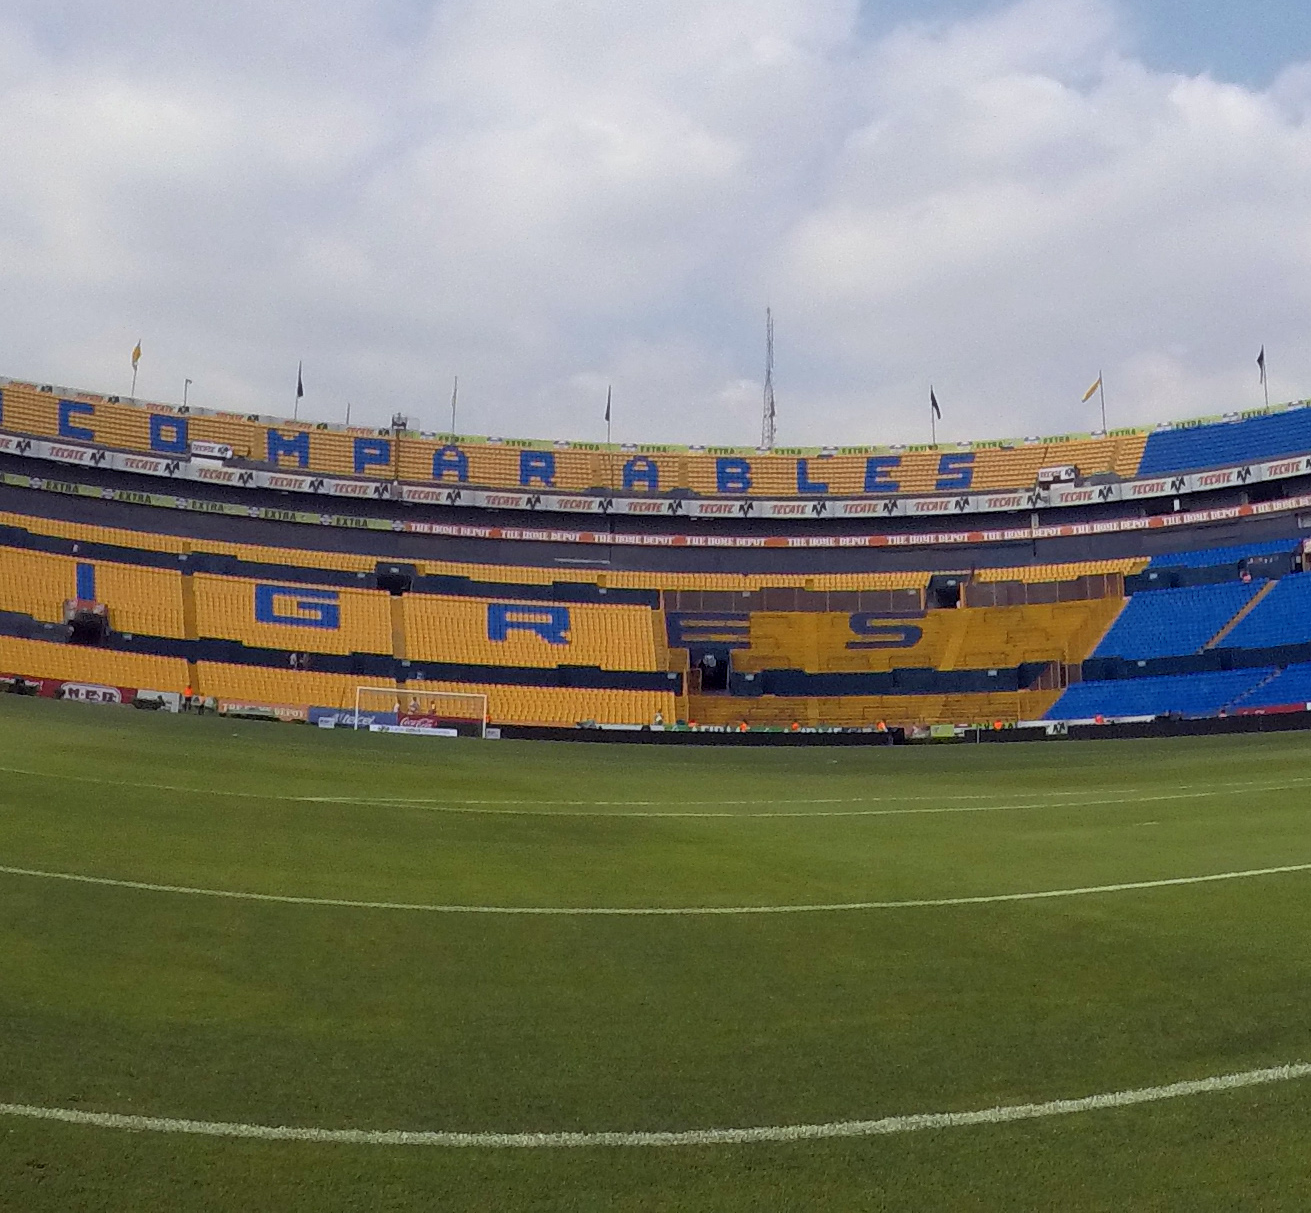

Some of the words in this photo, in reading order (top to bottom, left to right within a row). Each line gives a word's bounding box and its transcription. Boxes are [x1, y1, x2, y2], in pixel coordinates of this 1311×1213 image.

[48, 446, 87, 461] TECATE
[124, 458, 161, 472] TECATE
[1267, 461, 1302, 477] TECATE
[197, 468, 235, 481] TECATE
[1197, 472, 1233, 486] TECATE
[45, 481, 79, 493] EXTRA
[268, 476, 306, 489] TECATE
[1130, 482, 1167, 495] TECATE
[333, 483, 370, 495] TECATE
[405, 489, 442, 501] TECATE
[119, 492, 151, 503] EXTRA
[485, 495, 523, 506] TECATE
[987, 496, 1024, 508] TECATE
[1059, 490, 1095, 502] TECATE
[192, 501, 224, 511] EXTRA
[557, 499, 594, 510] TECATE
[627, 502, 663, 513] TECATE
[698, 503, 735, 514] TECATE
[770, 504, 808, 515] TECATE
[842, 503, 879, 514] TECATE
[914, 501, 951, 512] TECATE
[264, 510, 296, 520] EXTRA
[336, 518, 368, 527] EXTRA
[1072, 526, 1091, 534] THE
[1094, 522, 1118, 532] HOME
[1121, 519, 1149, 530] DEPOT
[888, 536, 907, 544] THE
[910, 535, 936, 544] HOME
[939, 533, 969, 542] DEPOT
[982, 531, 1002, 540] THE
[1004, 530, 1030, 539] HOME
[1033, 527, 1061, 537] DEPOT
[788, 538, 806, 546] THE
[809, 538, 835, 546] HOME
[840, 537, 870, 545] DEPOT
